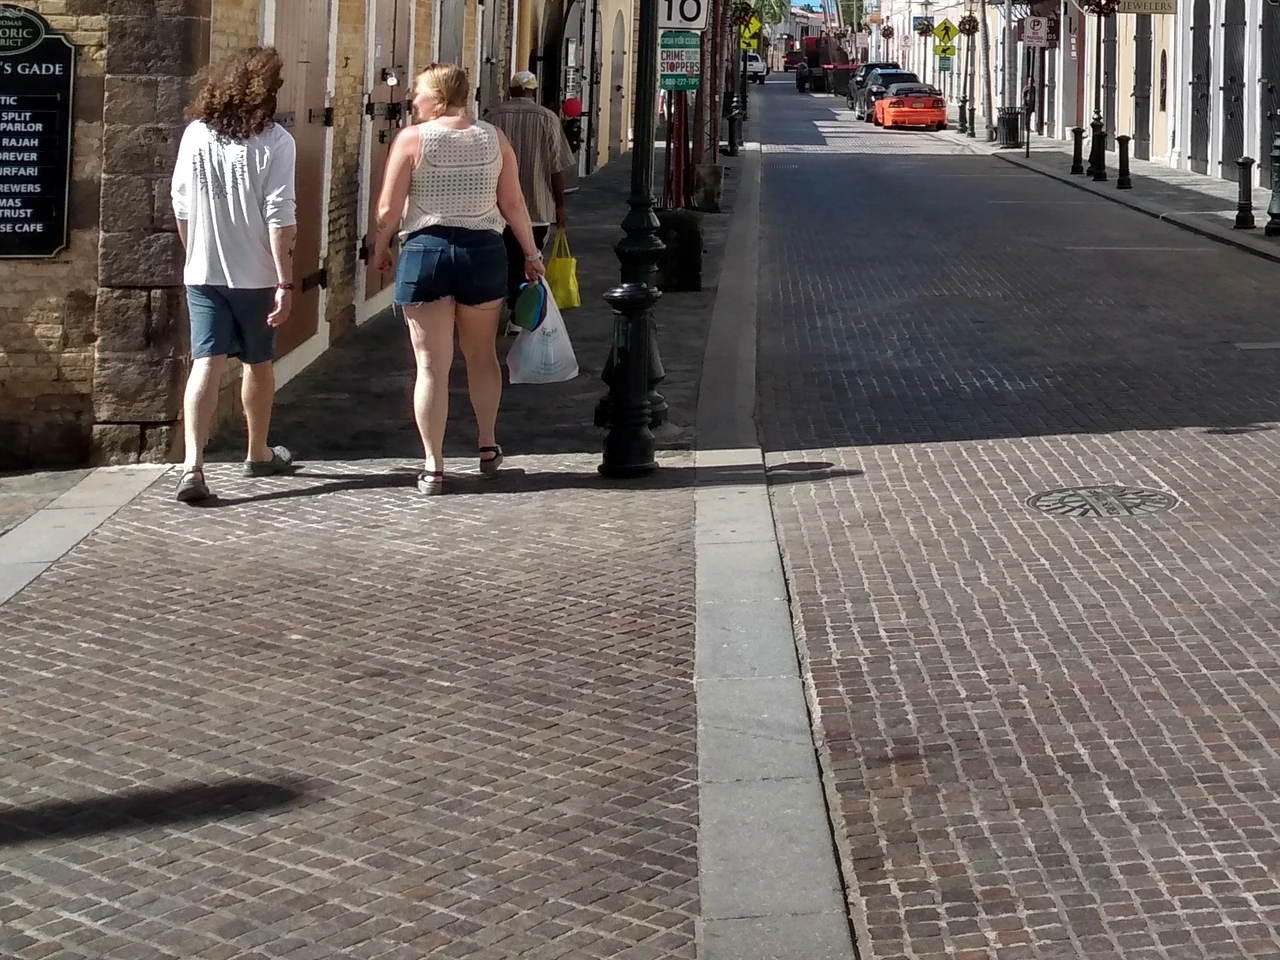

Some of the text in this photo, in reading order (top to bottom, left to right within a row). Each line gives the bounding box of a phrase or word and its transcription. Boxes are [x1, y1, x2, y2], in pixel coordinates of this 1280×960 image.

[1122, 1, 1173, 10] JEWELERS
[661, 50, 685, 61] CRIME
[17, 62, 64, 75] GADE
[660, 61, 700, 72] STOPPERS
[1, 112, 32, 121] SPLIT
[0, 122, 43, 132] PARLOR
[2, 138, 39, 147] RAJAH
[0, 209, 33, 218] TRUST
[14, 223, 43, 233] CAFE
